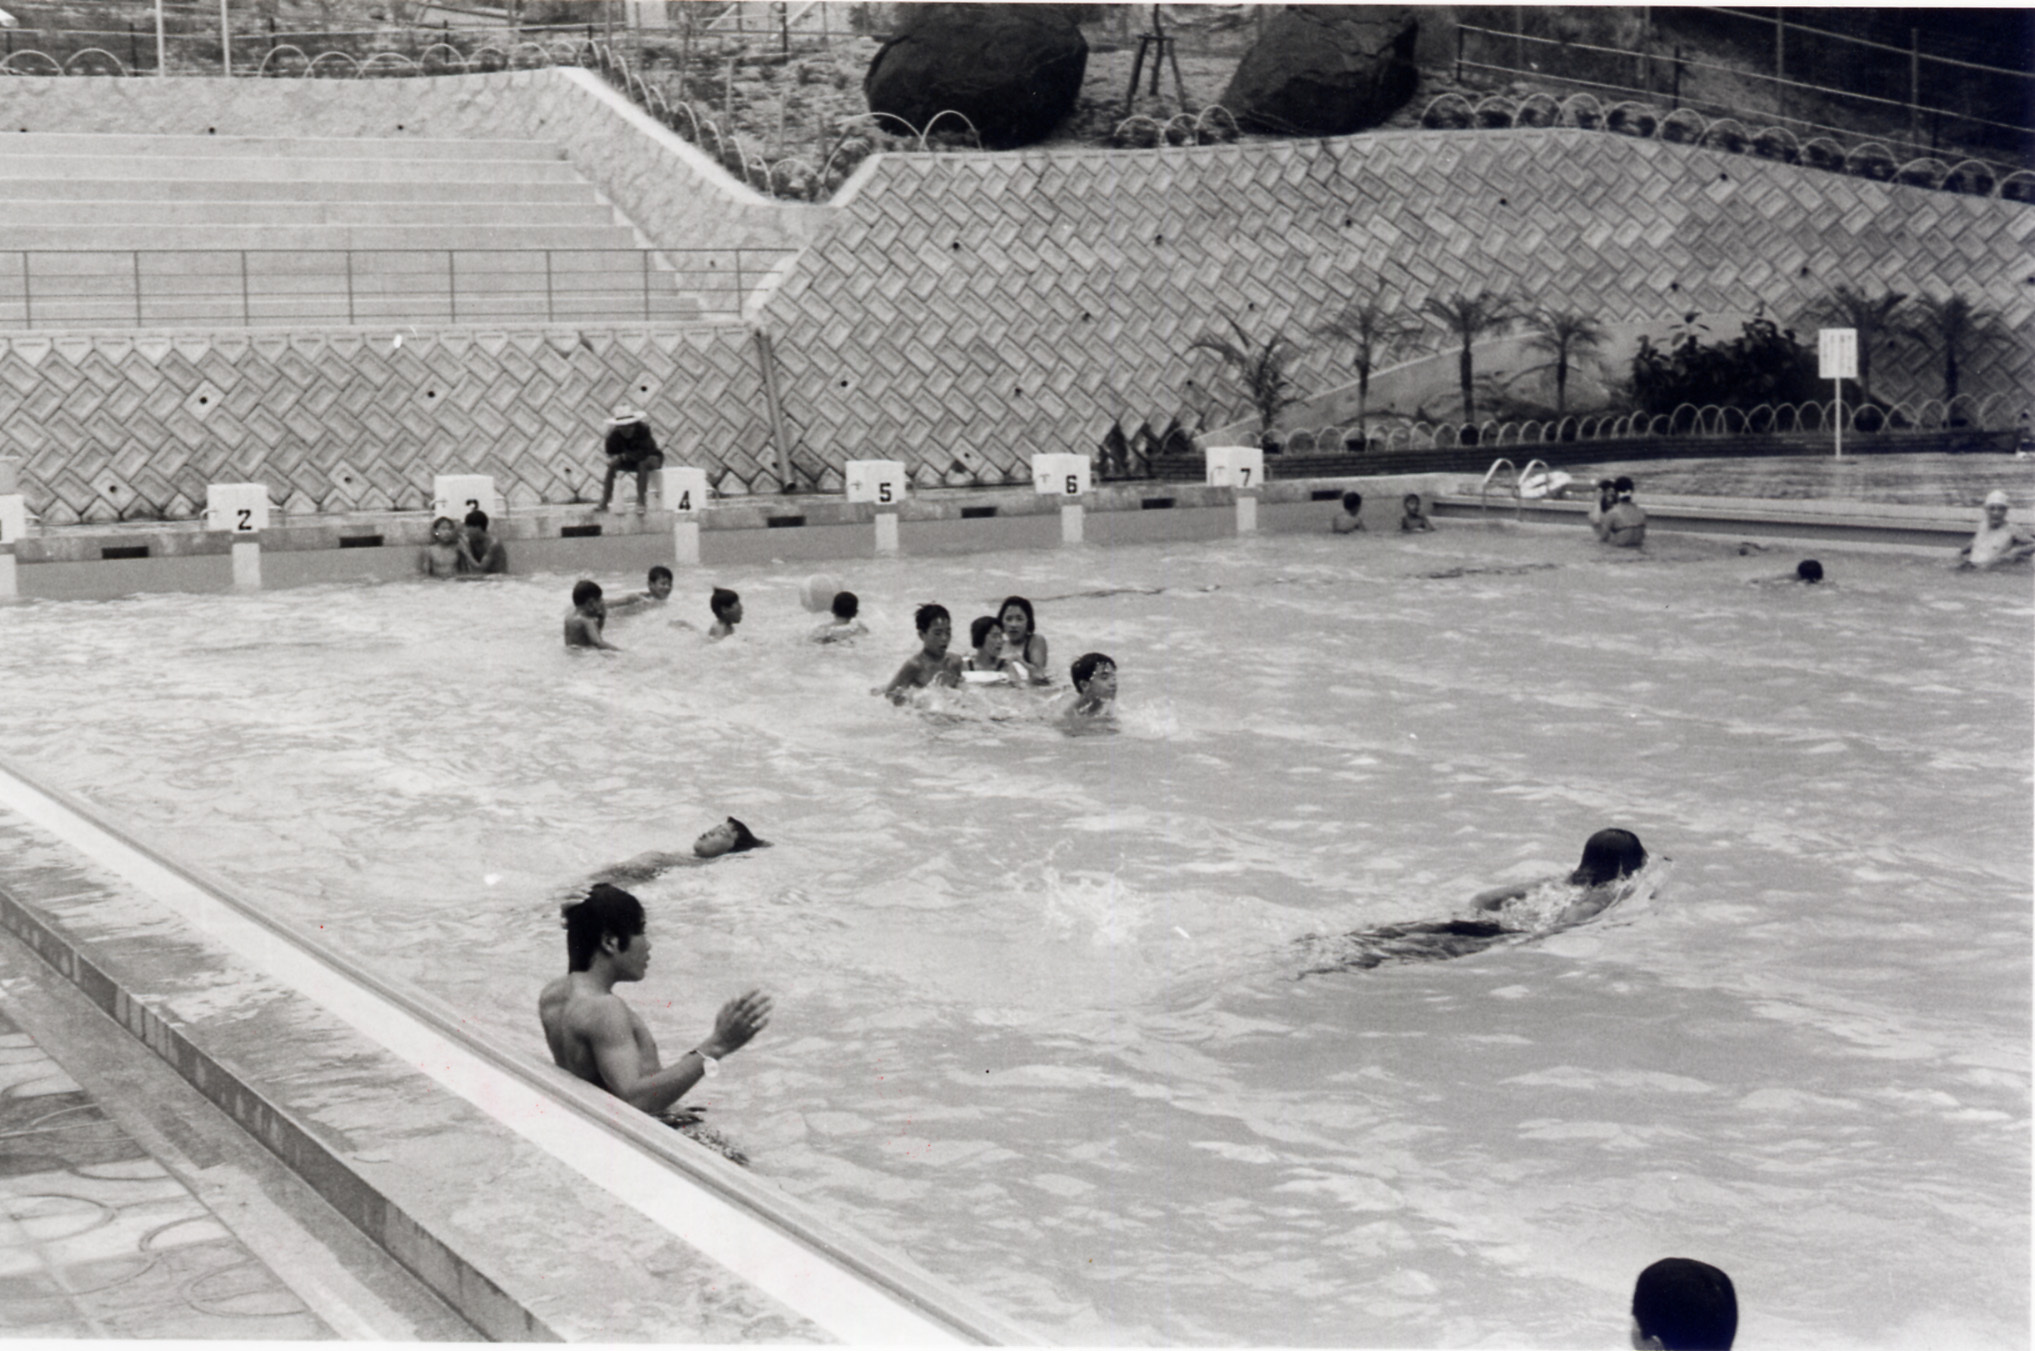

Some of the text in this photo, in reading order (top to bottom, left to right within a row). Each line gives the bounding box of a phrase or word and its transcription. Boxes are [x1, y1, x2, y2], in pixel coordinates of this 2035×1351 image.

[1065, 474, 1078, 494] 6
[1240, 467, 1251, 486] 7
[678, 490, 691, 511] 4
[879, 482, 892, 502] 5
[237, 509, 252, 530] 2
